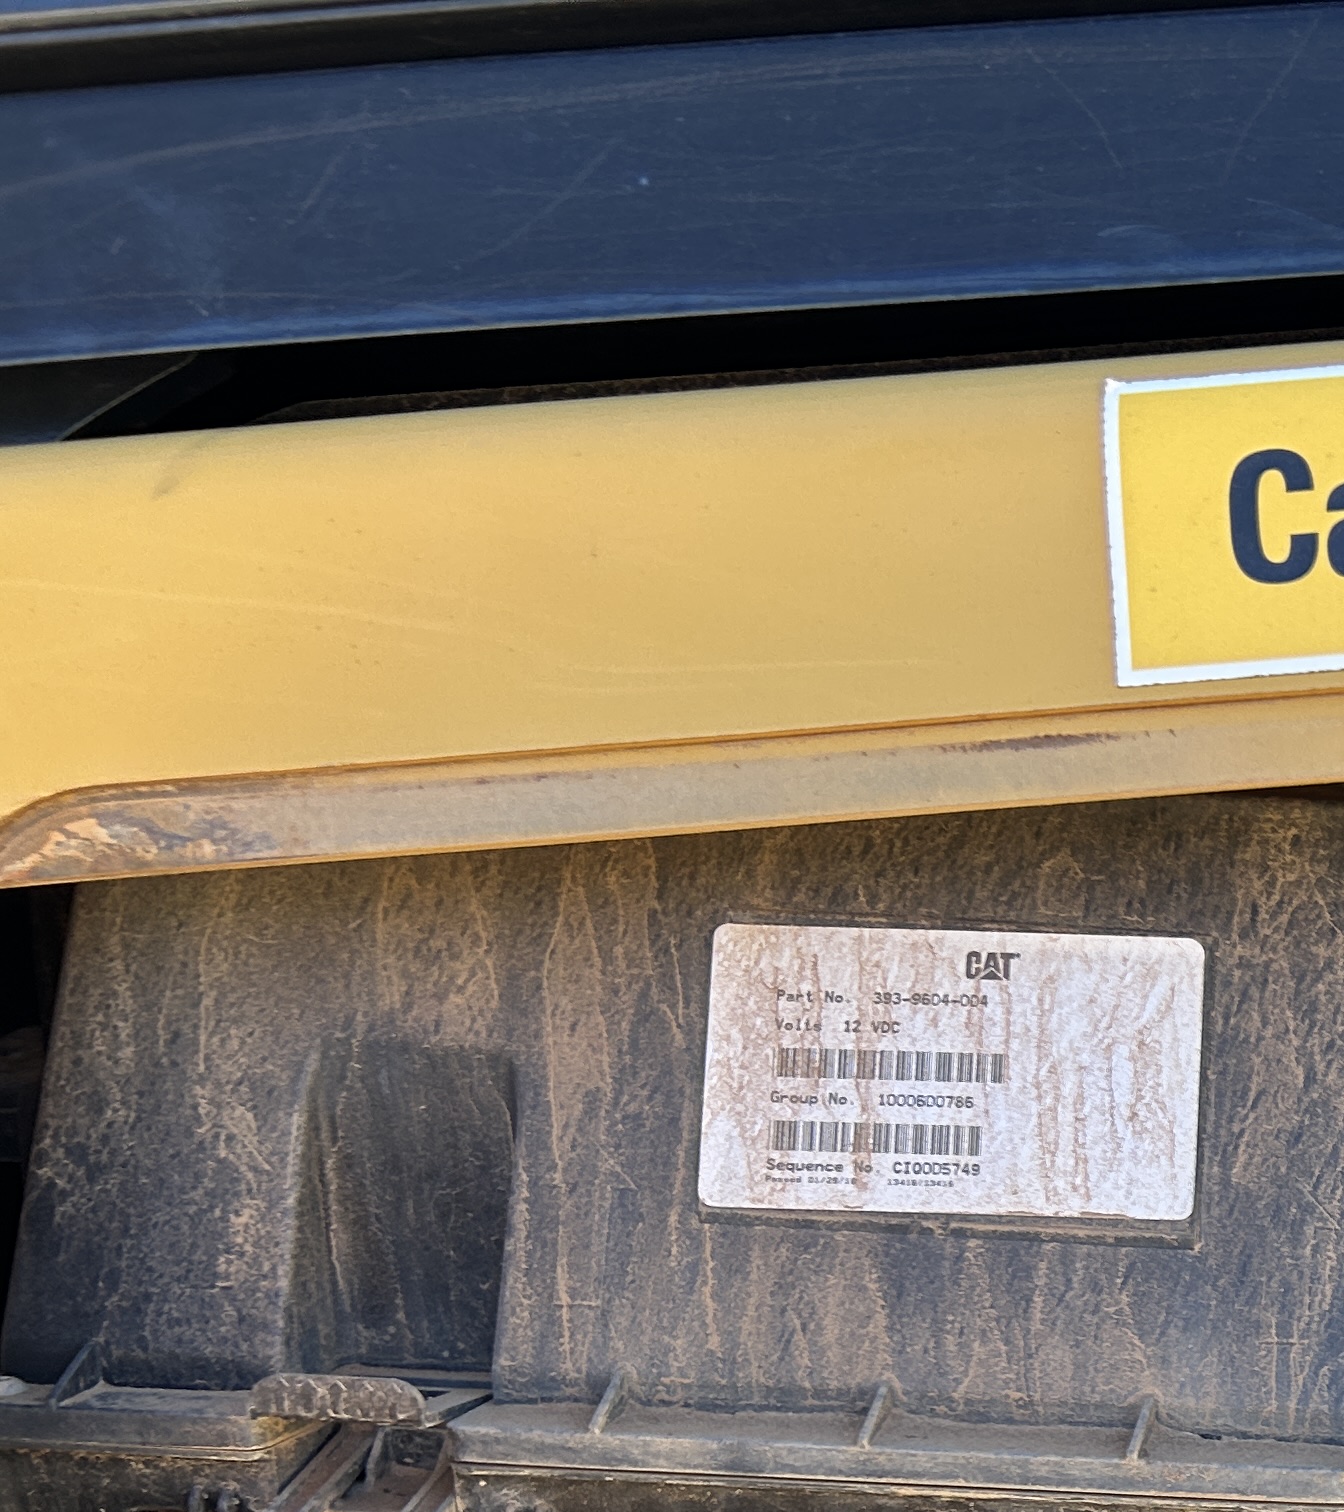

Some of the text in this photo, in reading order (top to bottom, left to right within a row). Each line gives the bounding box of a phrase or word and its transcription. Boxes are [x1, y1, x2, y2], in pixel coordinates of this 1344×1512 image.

[966, 950, 1017, 981] CAT
[775, 989, 812, 1003] Part
[825, 990, 850, 1004] No.
[775, 1018, 900, 1034] Volts 12 VDC
[770, 1091, 818, 1106] Group
[829, 1092, 854, 1106] No.
[766, 1158, 844, 1174] Sequence
[854, 1161, 880, 1174] No.
